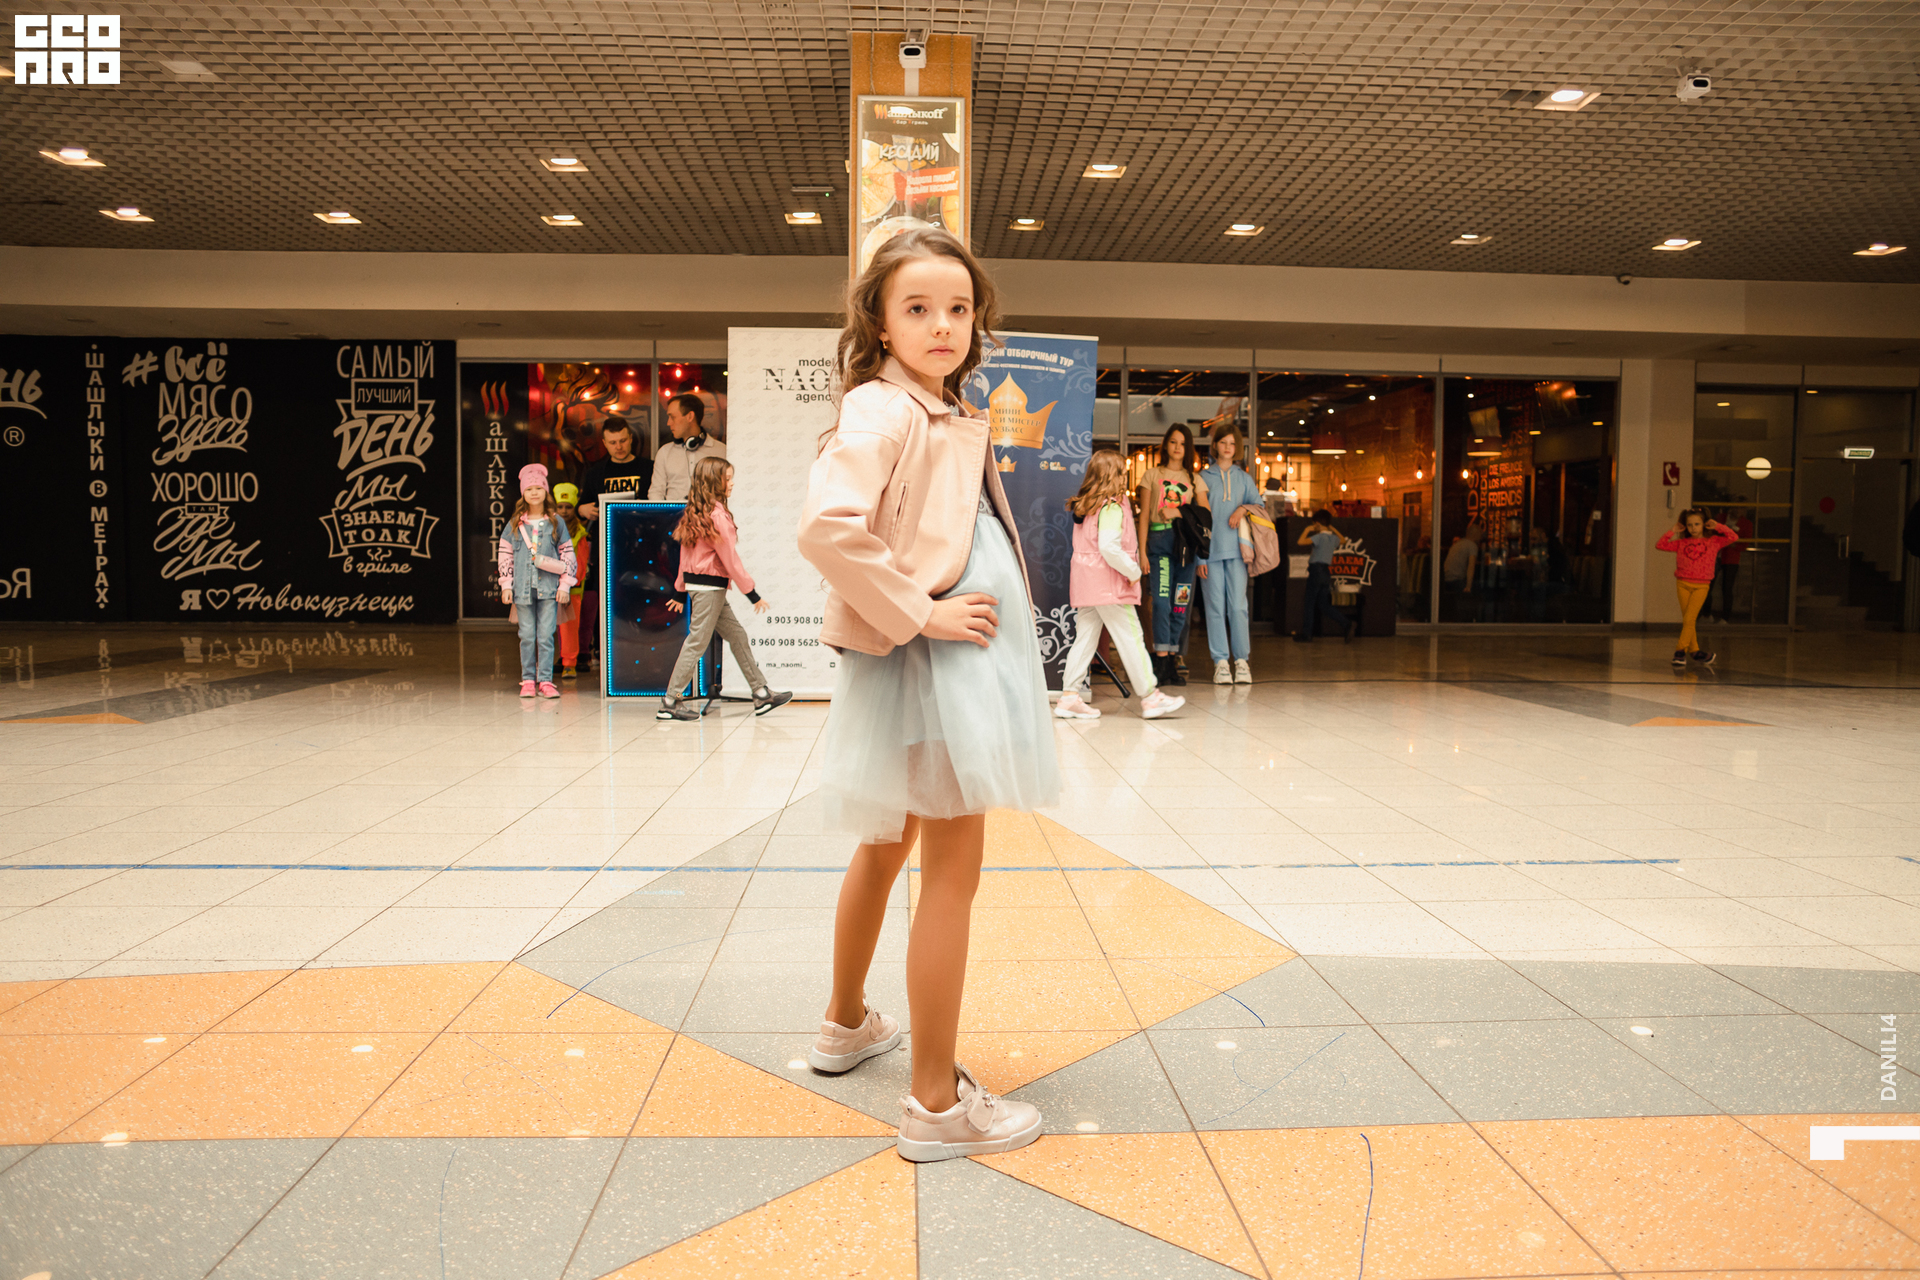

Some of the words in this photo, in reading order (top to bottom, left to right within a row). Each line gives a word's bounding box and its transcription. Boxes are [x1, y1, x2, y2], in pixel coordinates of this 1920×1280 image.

[336, 341, 434, 379] САМЫЙ
[1006, 347, 1059, 363] ОТБОРОЧНЫЙ
[1059, 356, 1075, 367] ТУР
[762, 368, 830, 392] NAO
[158, 382, 252, 424] МЯСО
[356, 385, 412, 404] ЛУЧШИЙ
[795, 393, 832, 403] agenc
[85, 352, 106, 471] ШАШЛЫКИ
[151, 472, 259, 502] ХОРОШО
[1488, 489, 1522, 507] FRIENDS
[341, 510, 415, 527] ЗНАЕМ
[343, 528, 411, 544] ТОЛК
[90, 506, 109, 603] МЕТРАХ
[355, 561, 412, 577] гриле
[232, 583, 414, 618] Новокузнецк
[766, 616, 772, 624] 8
[774, 616, 792, 624] 903
[794, 616, 811, 624] 908
[813, 616, 824, 624] 01
[750, 638, 756, 646] 8
[758, 638, 776, 646] 960
[778, 638, 795, 646] 908
[798, 638, 820, 646] 5625
